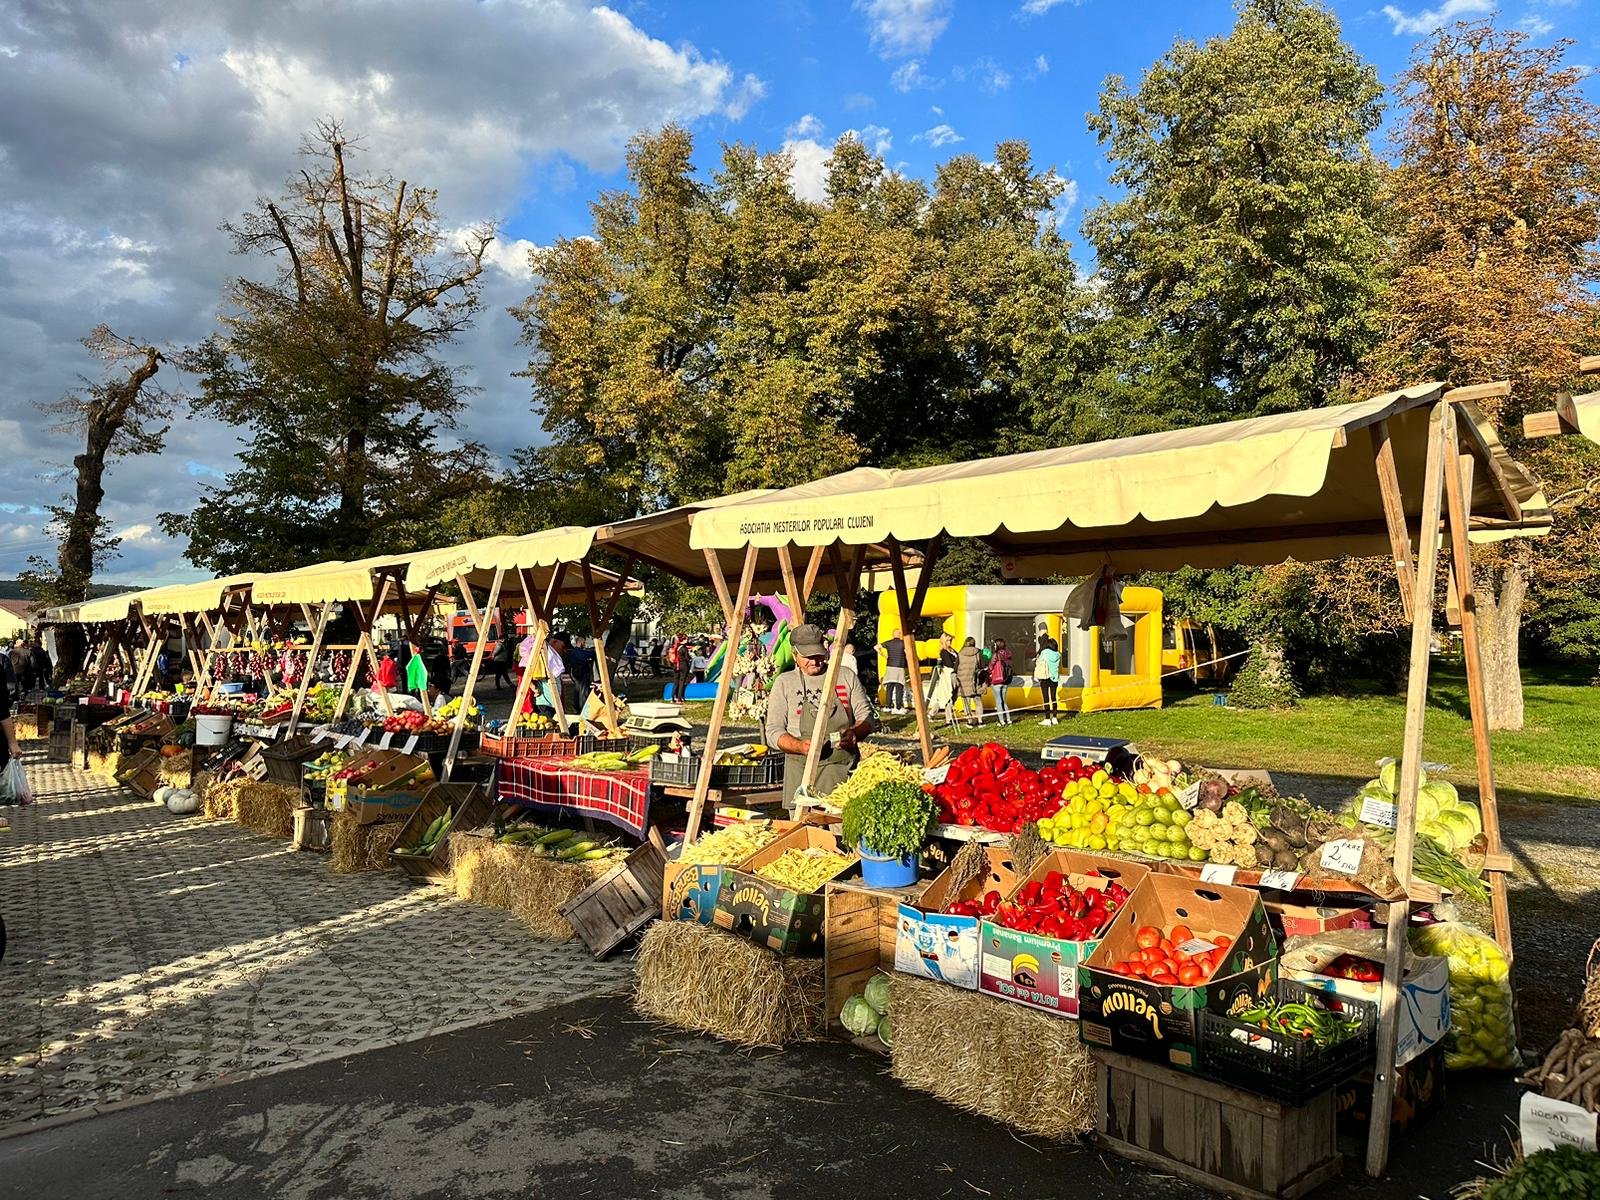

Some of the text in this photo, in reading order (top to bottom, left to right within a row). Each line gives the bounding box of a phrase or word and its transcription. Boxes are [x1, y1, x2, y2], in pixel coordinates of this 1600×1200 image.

[740, 515, 874, 535] ASOCIATIA MESTERILOR POPULARI CLUJENI
[992, 928, 1061, 951] Premium Bananas
[996, 980, 1059, 1008] RUTA del SOL
[1102, 991, 1164, 1040] yellow
